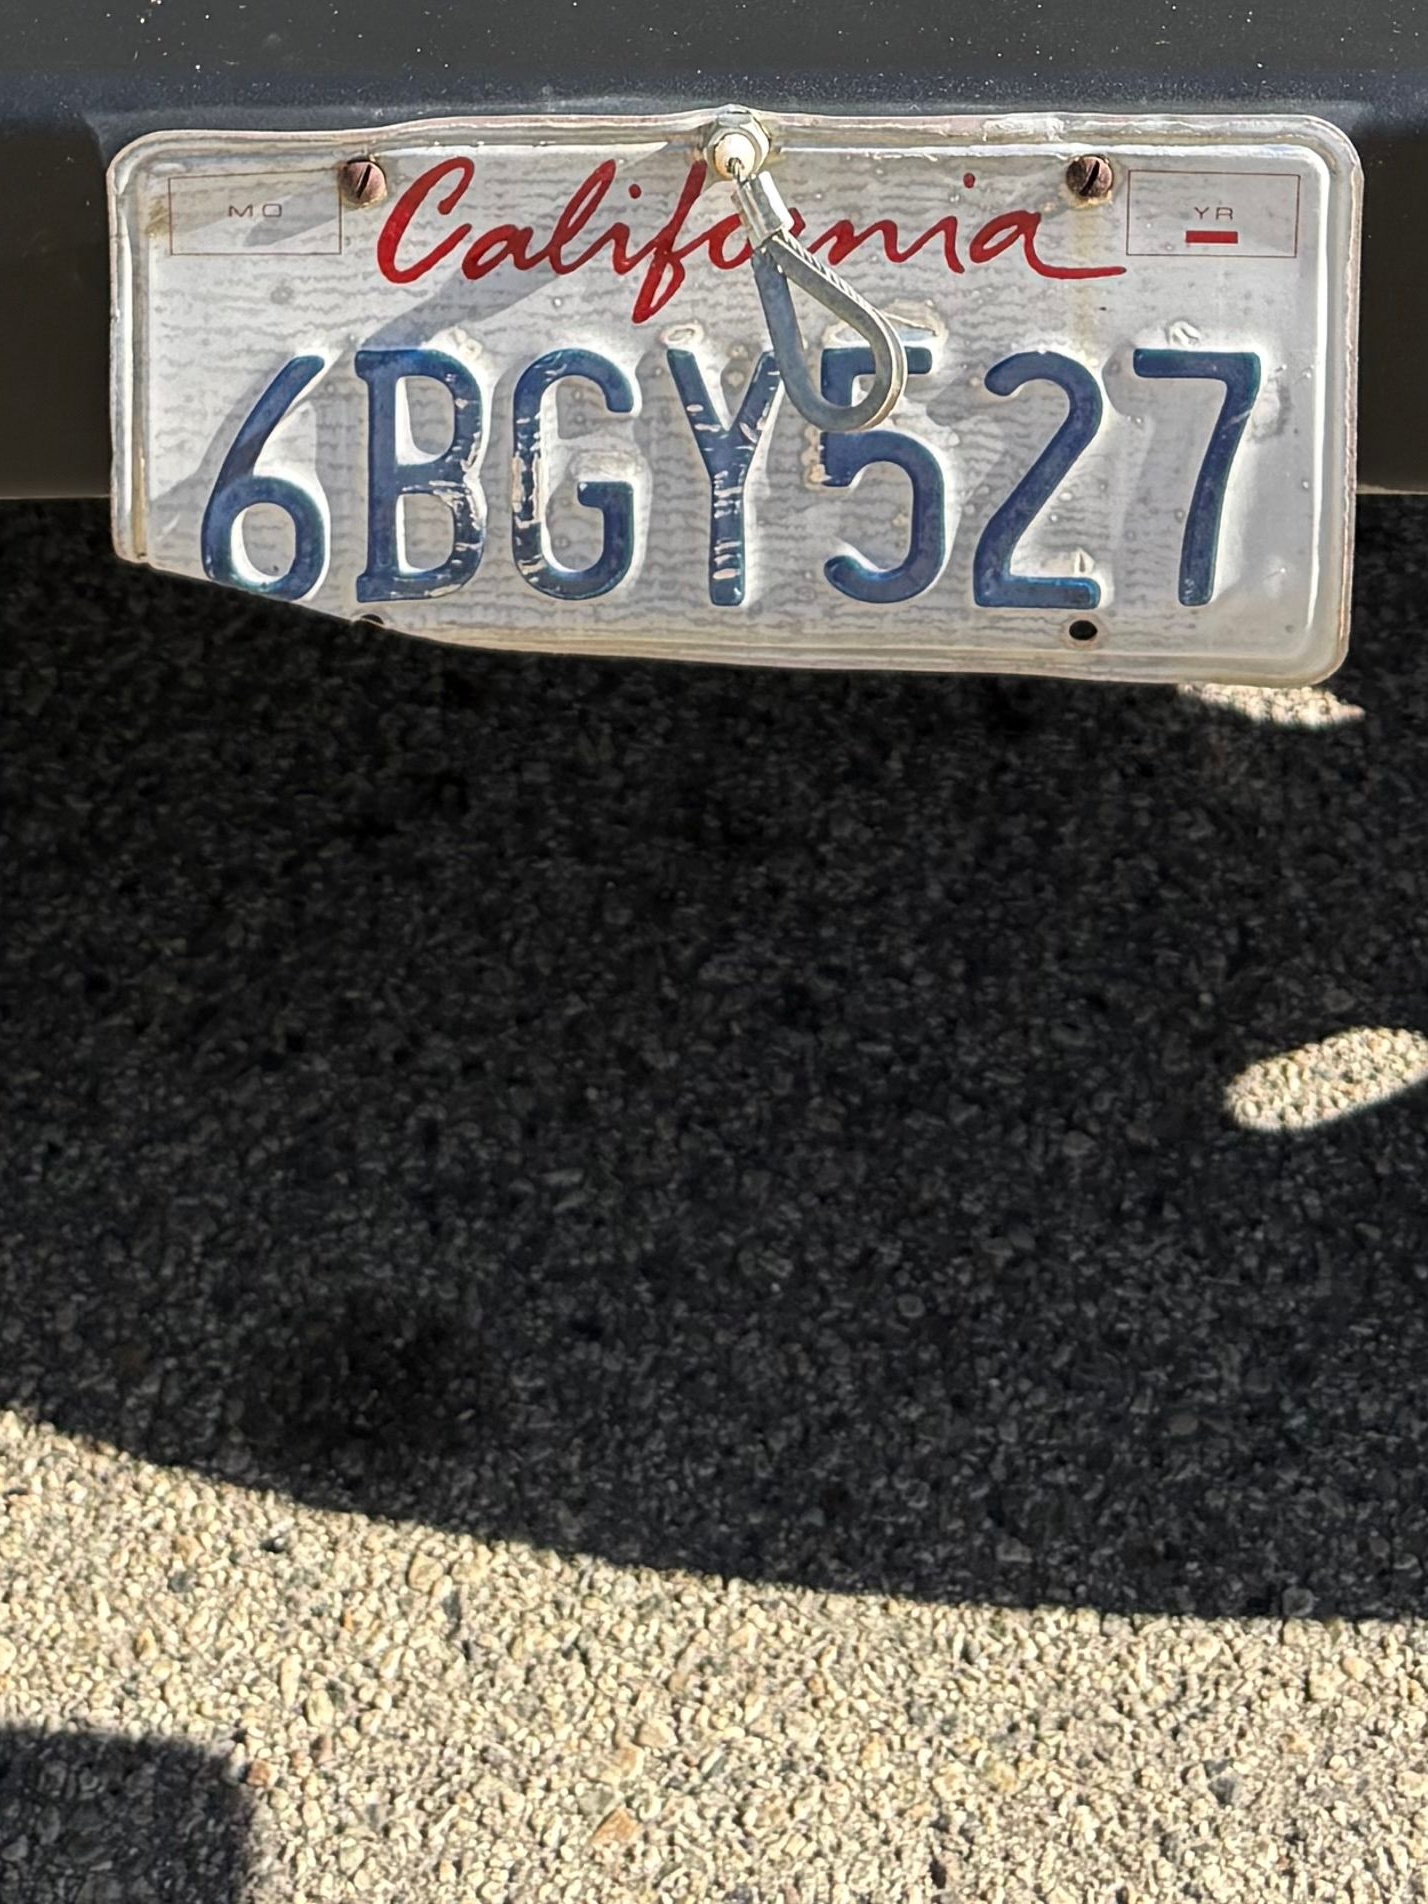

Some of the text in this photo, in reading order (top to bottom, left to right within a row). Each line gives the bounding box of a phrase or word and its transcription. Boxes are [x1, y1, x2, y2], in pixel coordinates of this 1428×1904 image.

[227, 203, 283, 218] MO
[1193, 206, 1234, 220] YR
[200, 347, 1262, 609] 6BGY527
